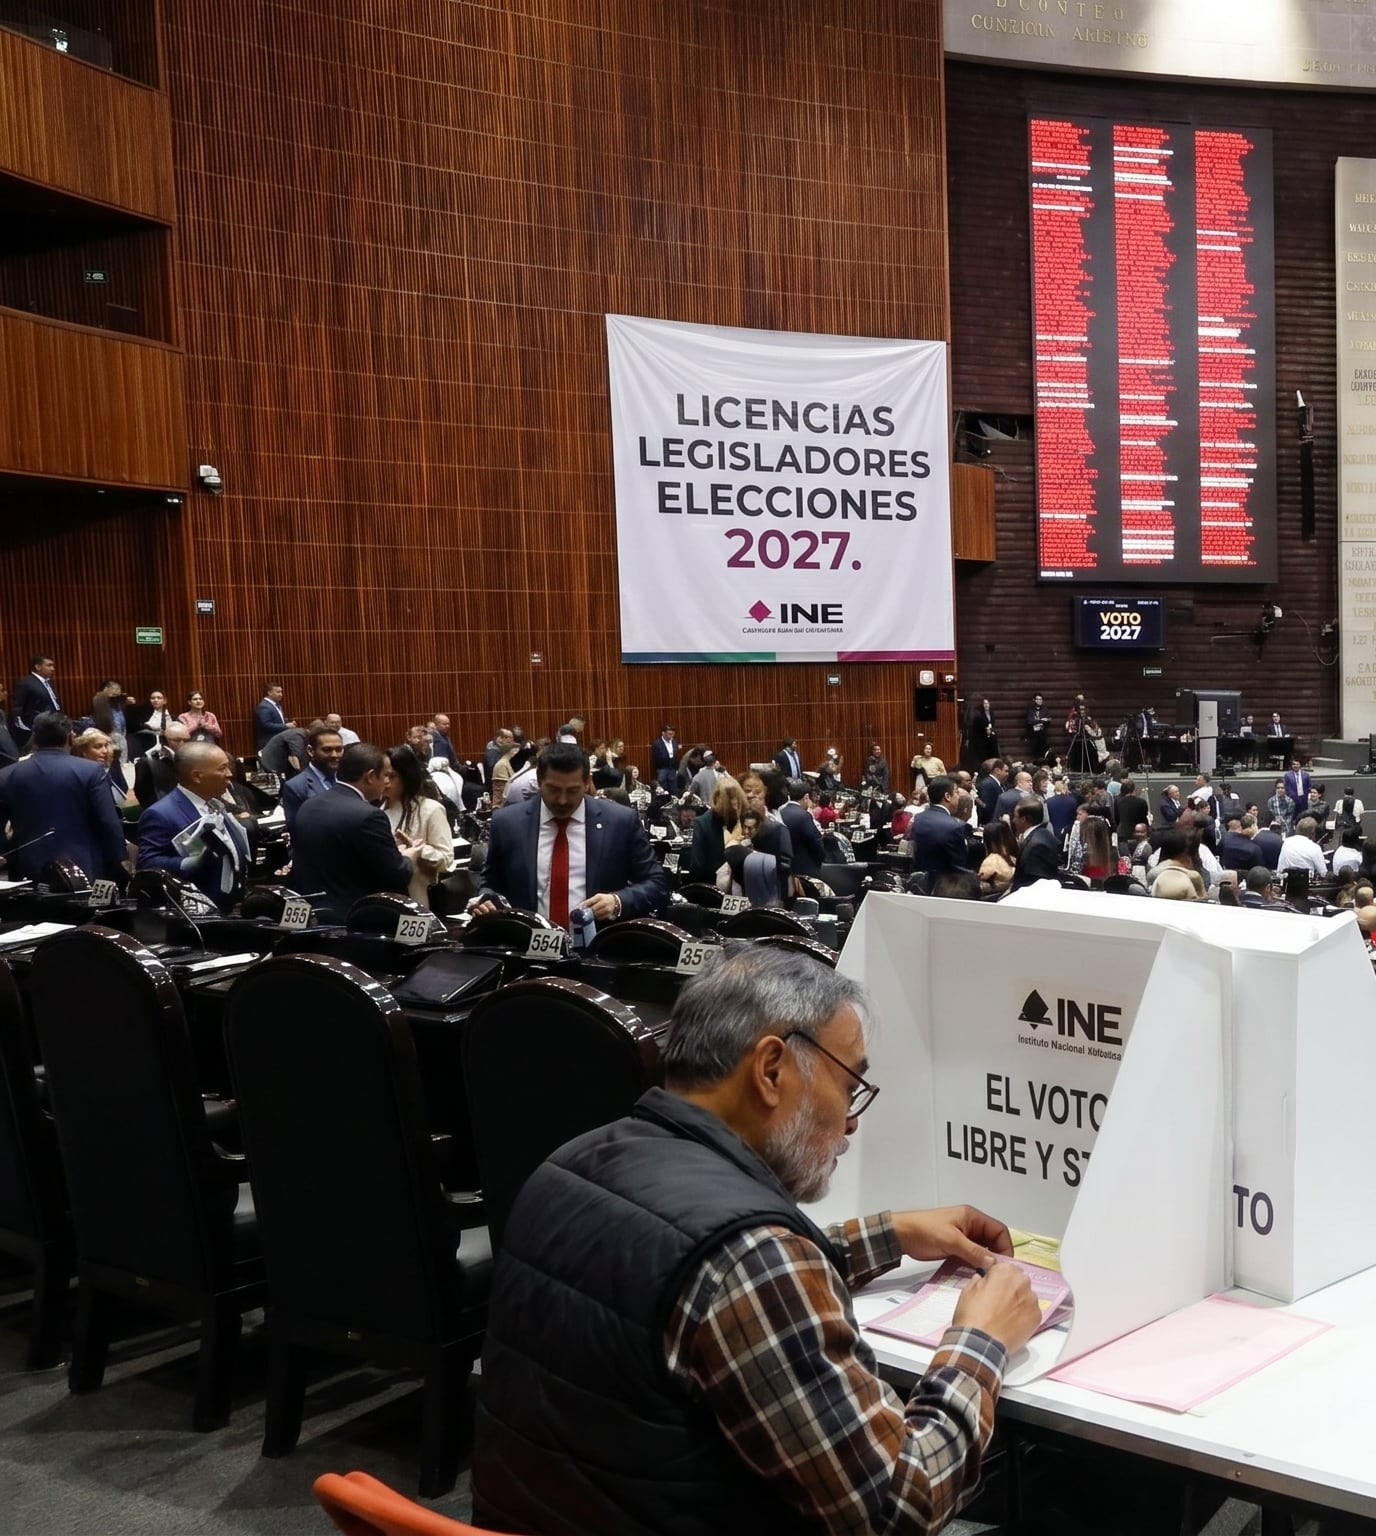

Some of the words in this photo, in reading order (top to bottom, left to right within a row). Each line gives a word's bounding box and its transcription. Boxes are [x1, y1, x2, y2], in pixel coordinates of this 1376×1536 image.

[676, 393, 895, 437] LICENCIAS
[639, 436, 931, 479] LEGISLADORES
[657, 481, 917, 521] ELECCIONES
[724, 528, 862, 571] 2027.
[780, 603, 844, 624] INE
[1100, 612, 1141, 625] VOTO
[1100, 625, 1141, 640] 2027
[1057, 998, 1123, 1046] INE
[1018, 1034, 1049, 1048] Instituto
[1051, 1040, 1085, 1054] Nacional
[987, 1073, 1020, 1116] EL
[947, 1121, 1027, 1175] LIBRE
[1035, 1141, 1054, 1180] Y
[1063, 1147, 1090, 1188] S
